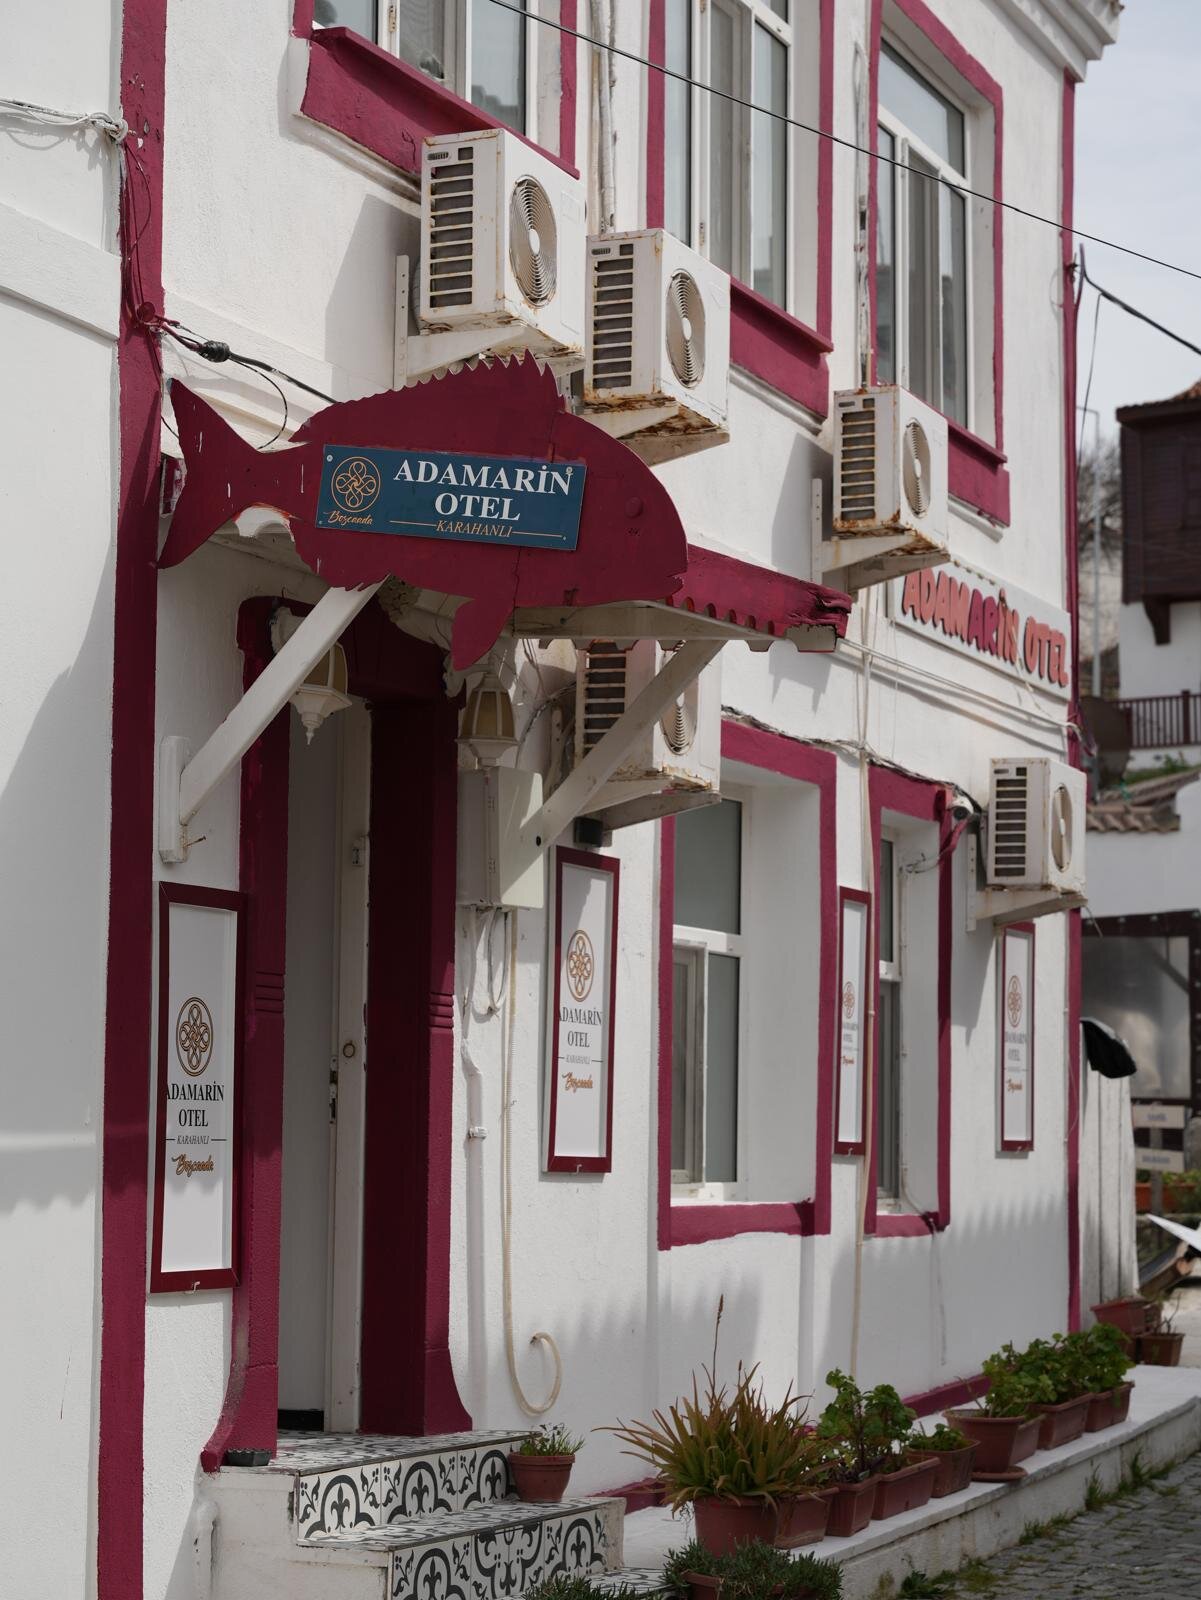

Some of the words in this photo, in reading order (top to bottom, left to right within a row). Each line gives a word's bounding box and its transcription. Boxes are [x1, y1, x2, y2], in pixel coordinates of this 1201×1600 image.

[393, 458, 572, 496] ADAMARİN
[435, 492, 521, 521] OTEL
[436, 519, 513, 538] KARAHANLI
[1024, 616, 1068, 687] OTEL
[567, 1030, 590, 1048] OTEL
[178, 1108, 209, 1127] OTEL
[176, 1135, 210, 1145] KARAHANLI
